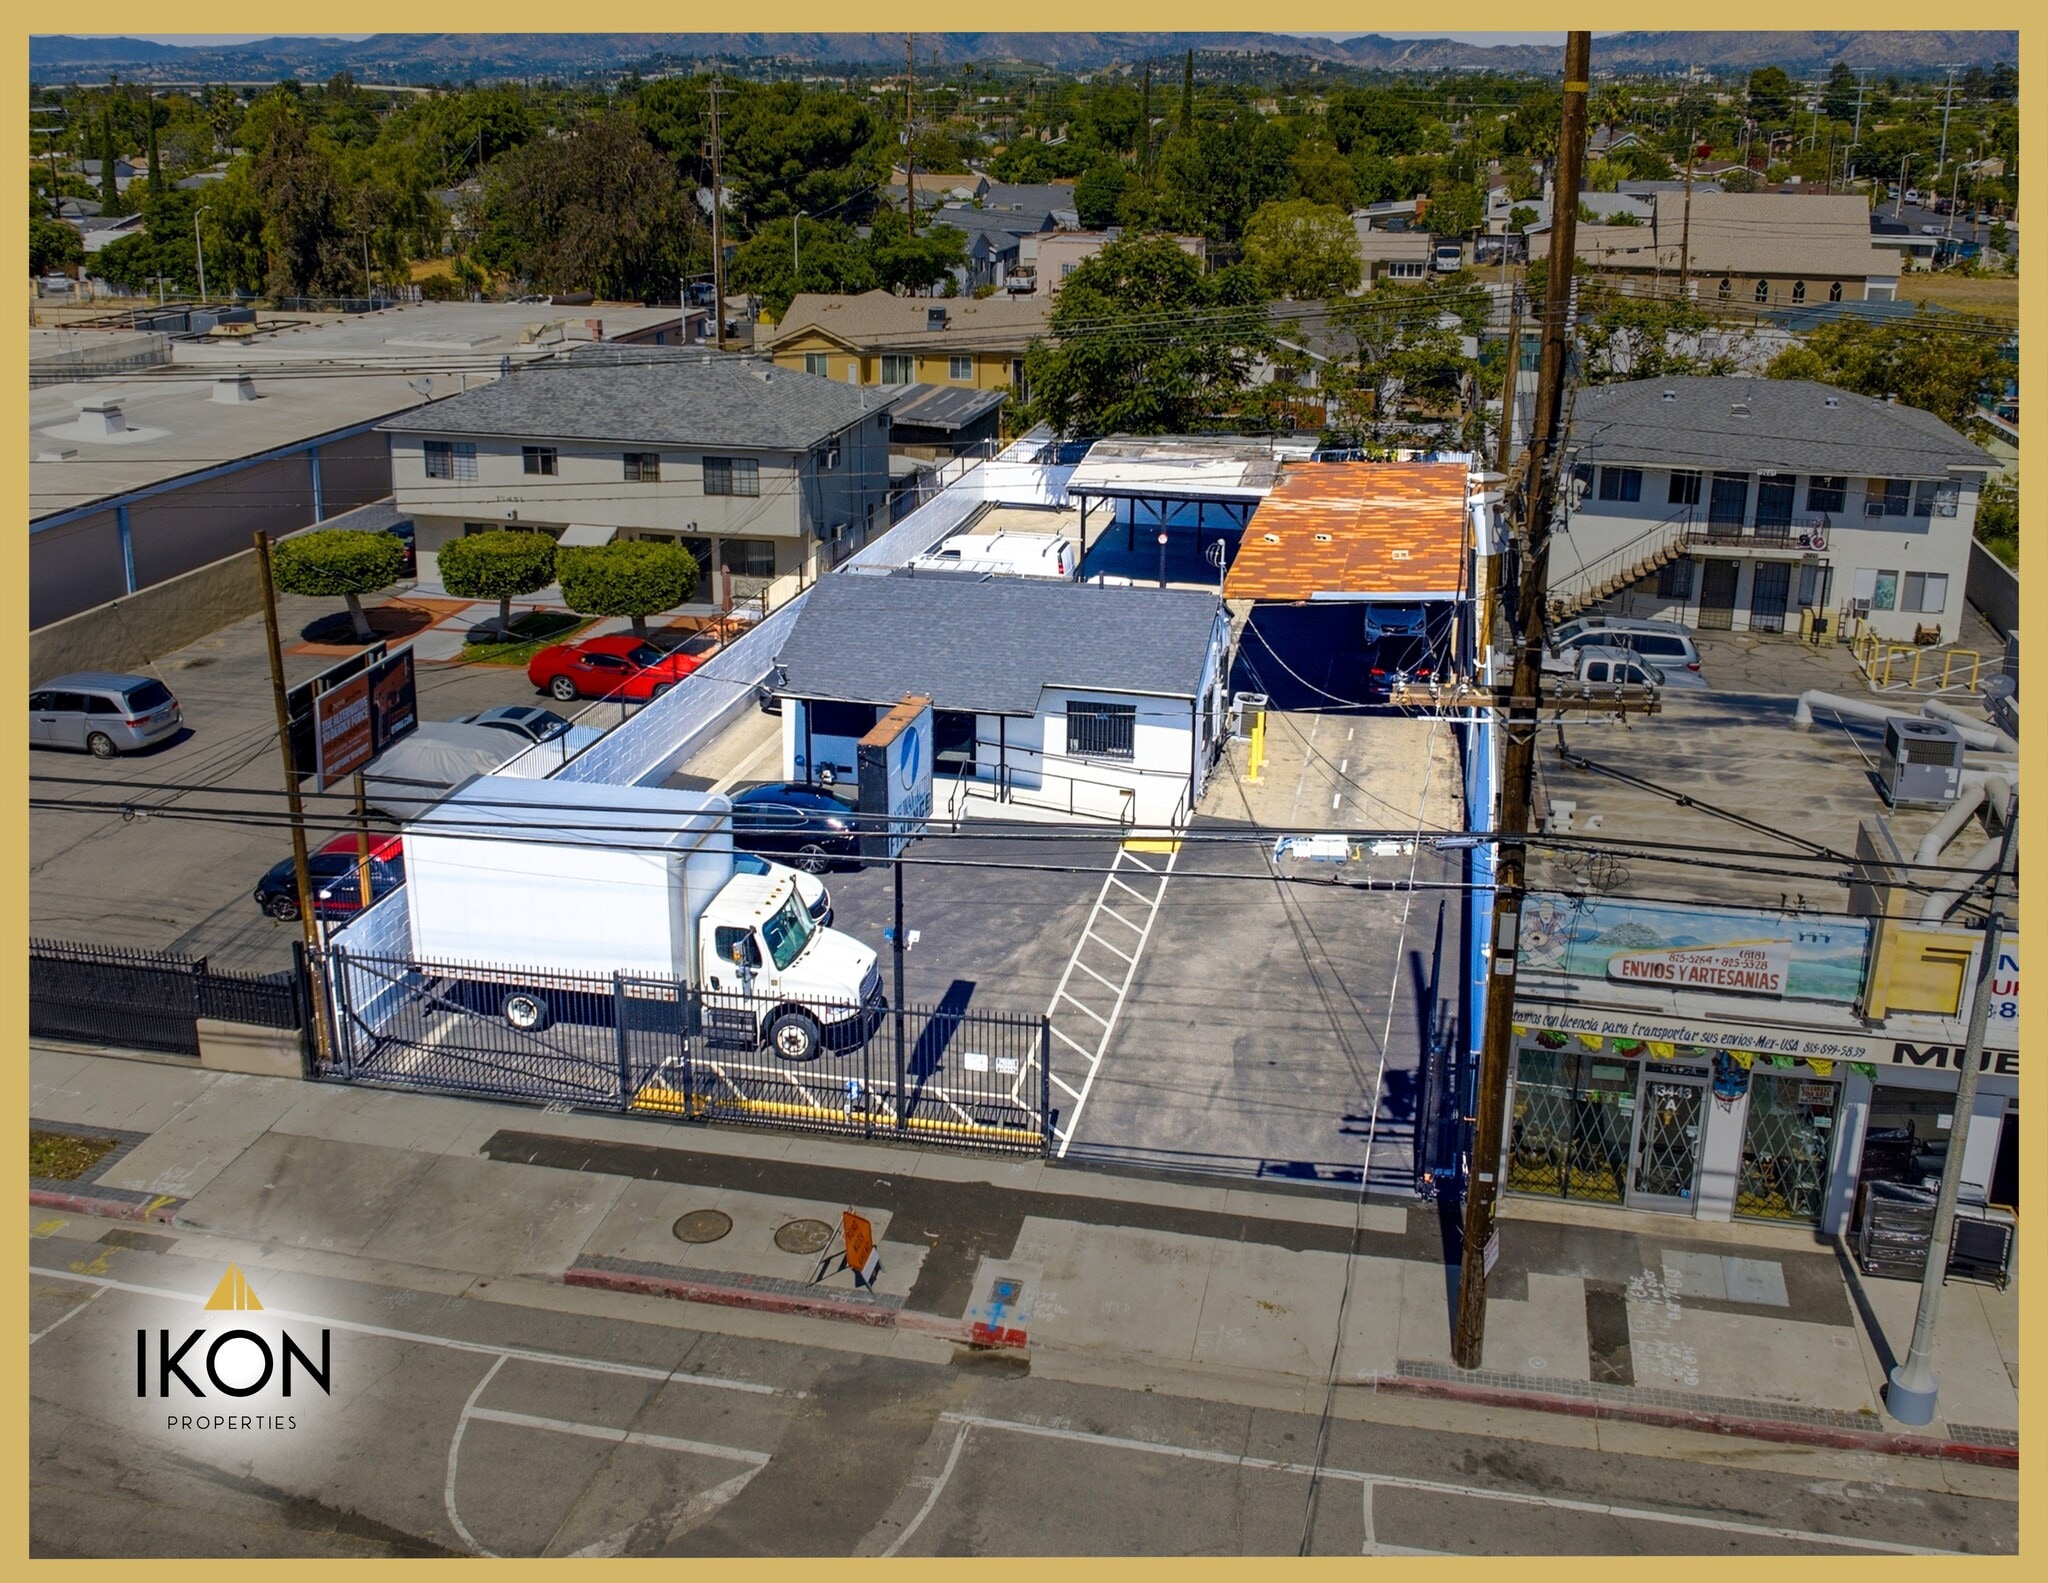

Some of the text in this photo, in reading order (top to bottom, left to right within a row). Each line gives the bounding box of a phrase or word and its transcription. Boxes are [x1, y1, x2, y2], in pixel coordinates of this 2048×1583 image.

[1622, 959, 1780, 990] ENVIOS Y ARTESANIAS
[1602, 1021, 1629, 1034] para
[1631, 1022, 1699, 1042] transportar
[1700, 1032, 1718, 1044] sus
